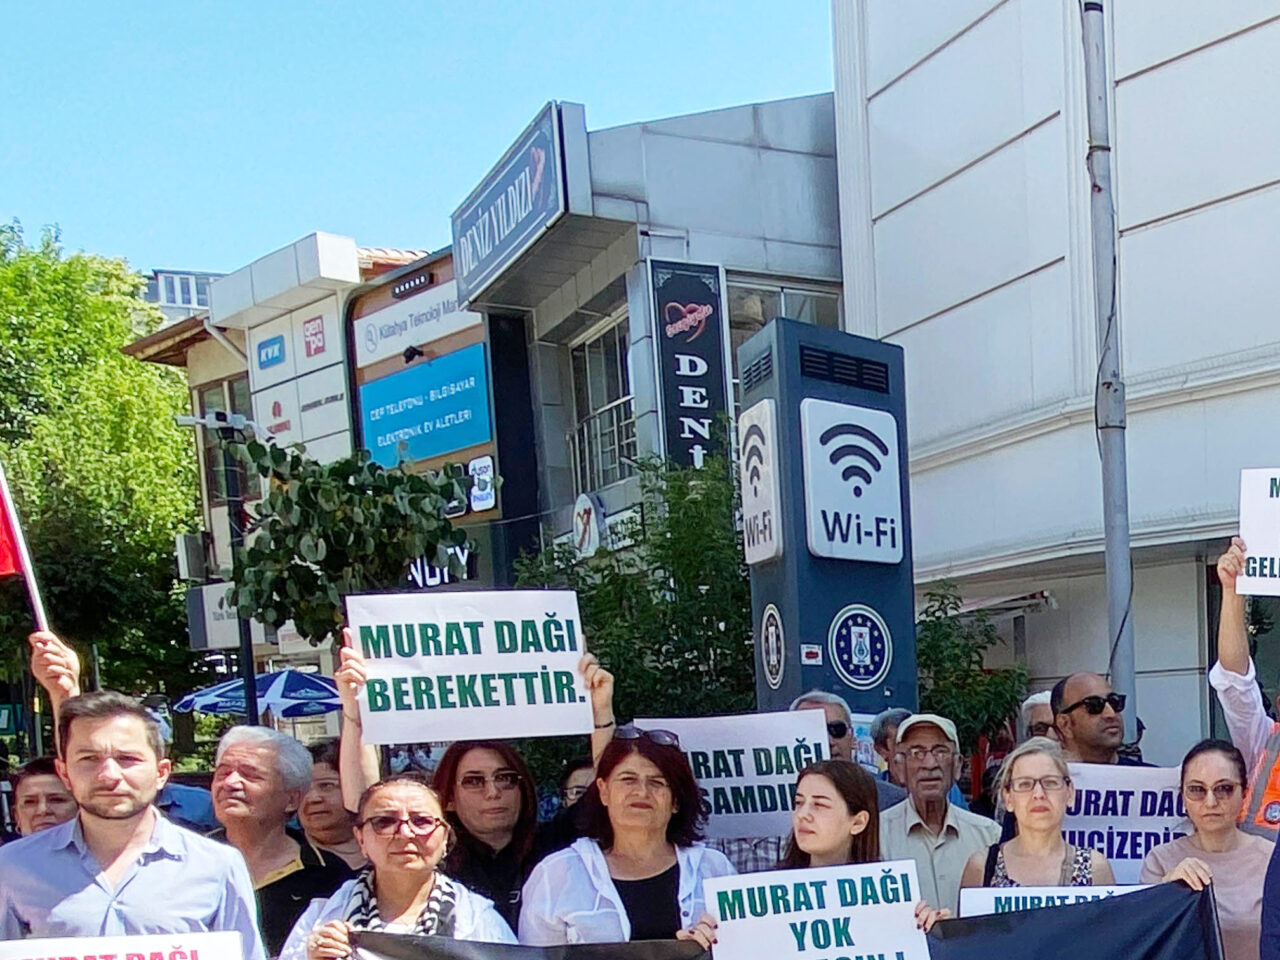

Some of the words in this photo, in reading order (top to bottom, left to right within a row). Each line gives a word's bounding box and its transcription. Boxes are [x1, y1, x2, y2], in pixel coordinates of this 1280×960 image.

[261, 343, 280, 362] KVK
[745, 510, 772, 548] Wi-Fi
[820, 509, 896, 549] Wi-Fi
[359, 621, 484, 659] MURAT
[494, 612, 578, 654] DAĞI
[366, 665, 586, 713] BEREKETTİR.
[686, 749, 745, 779] RAT
[1065, 789, 1134, 817] URAT
[717, 880, 828, 922] MURAT
[837, 868, 912, 908] DAĞI
[789, 916, 855, 952] YOK
